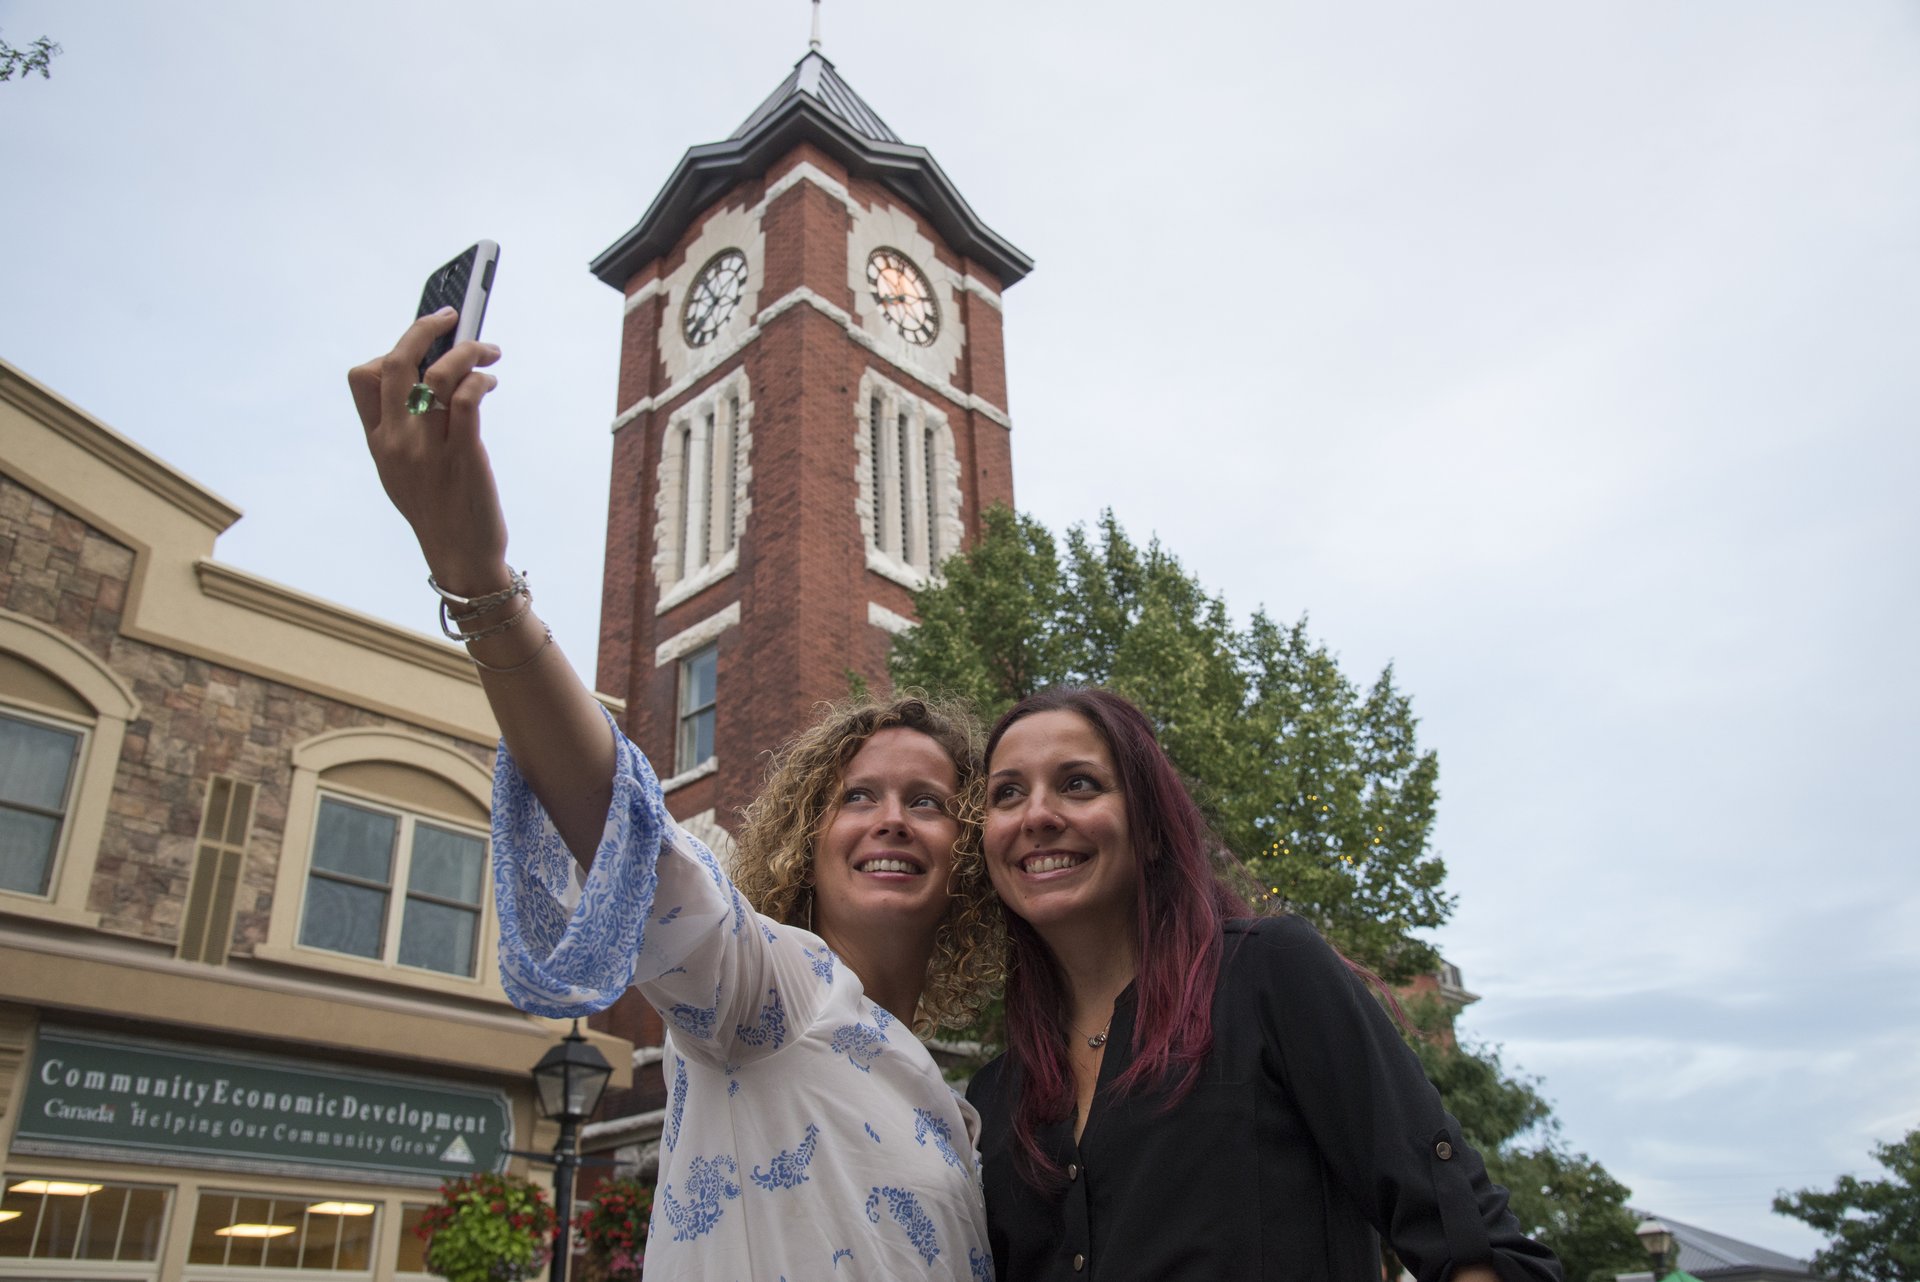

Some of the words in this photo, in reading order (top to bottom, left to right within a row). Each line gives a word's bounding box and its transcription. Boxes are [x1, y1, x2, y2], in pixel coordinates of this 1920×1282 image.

[41, 1059, 209, 1107] Community
[212, 1079, 338, 1117] Economic
[342, 1095, 486, 1134] Development
[44, 1098, 116, 1124] Canada
[230, 1118, 268, 1139] Our
[273, 1123, 385, 1154] Community
